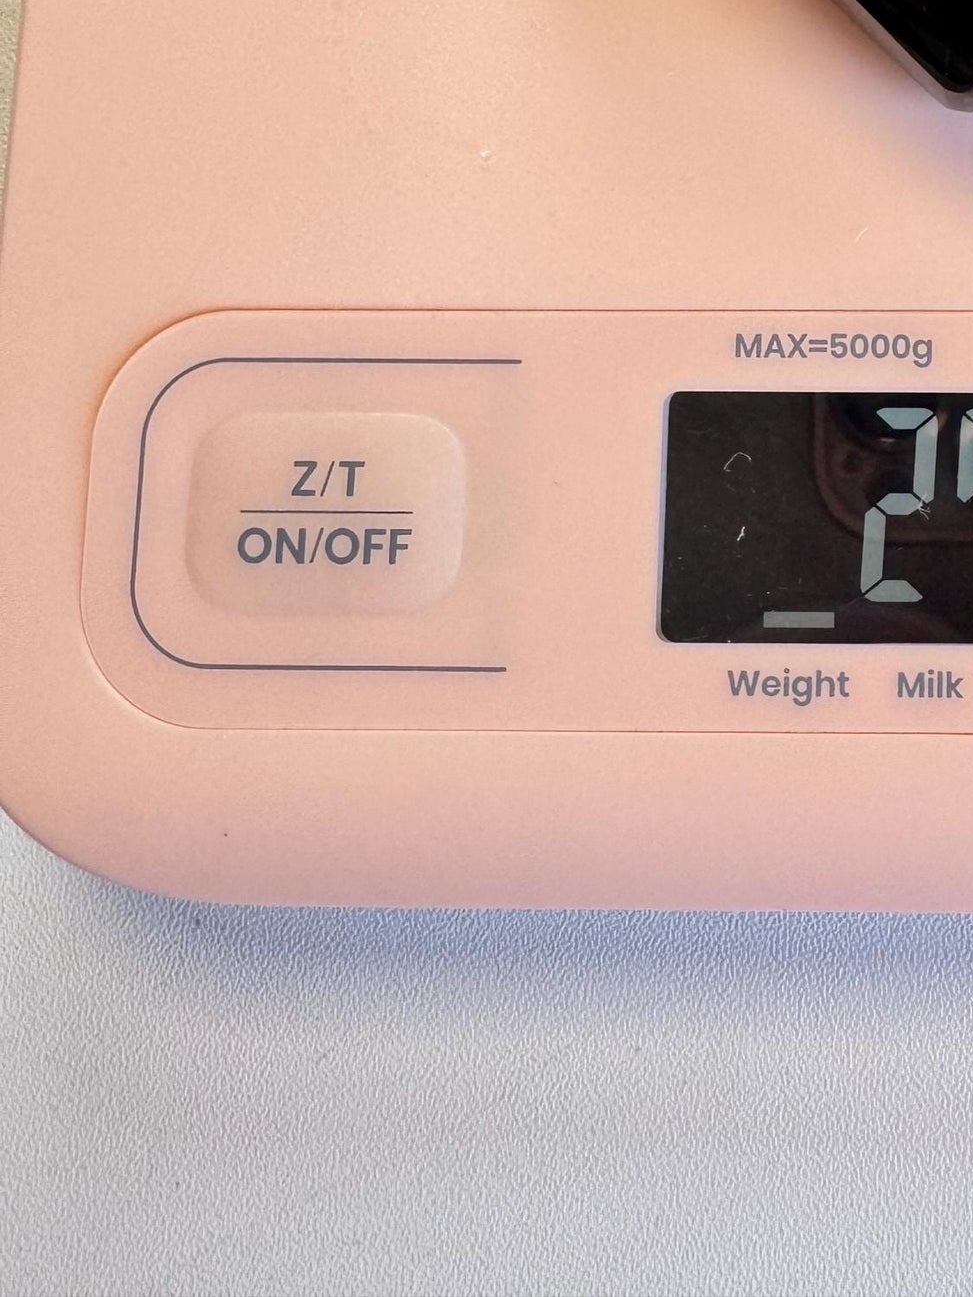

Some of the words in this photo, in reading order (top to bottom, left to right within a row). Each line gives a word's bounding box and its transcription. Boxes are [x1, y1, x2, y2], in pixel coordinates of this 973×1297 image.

[734, 333, 933, 367] MAX=5000g
[291, 460, 365, 497] Z/T
[237, 526, 413, 565] ON/OFF
[727, 668, 850, 705] Weight
[897, 669, 964, 700] Milk
